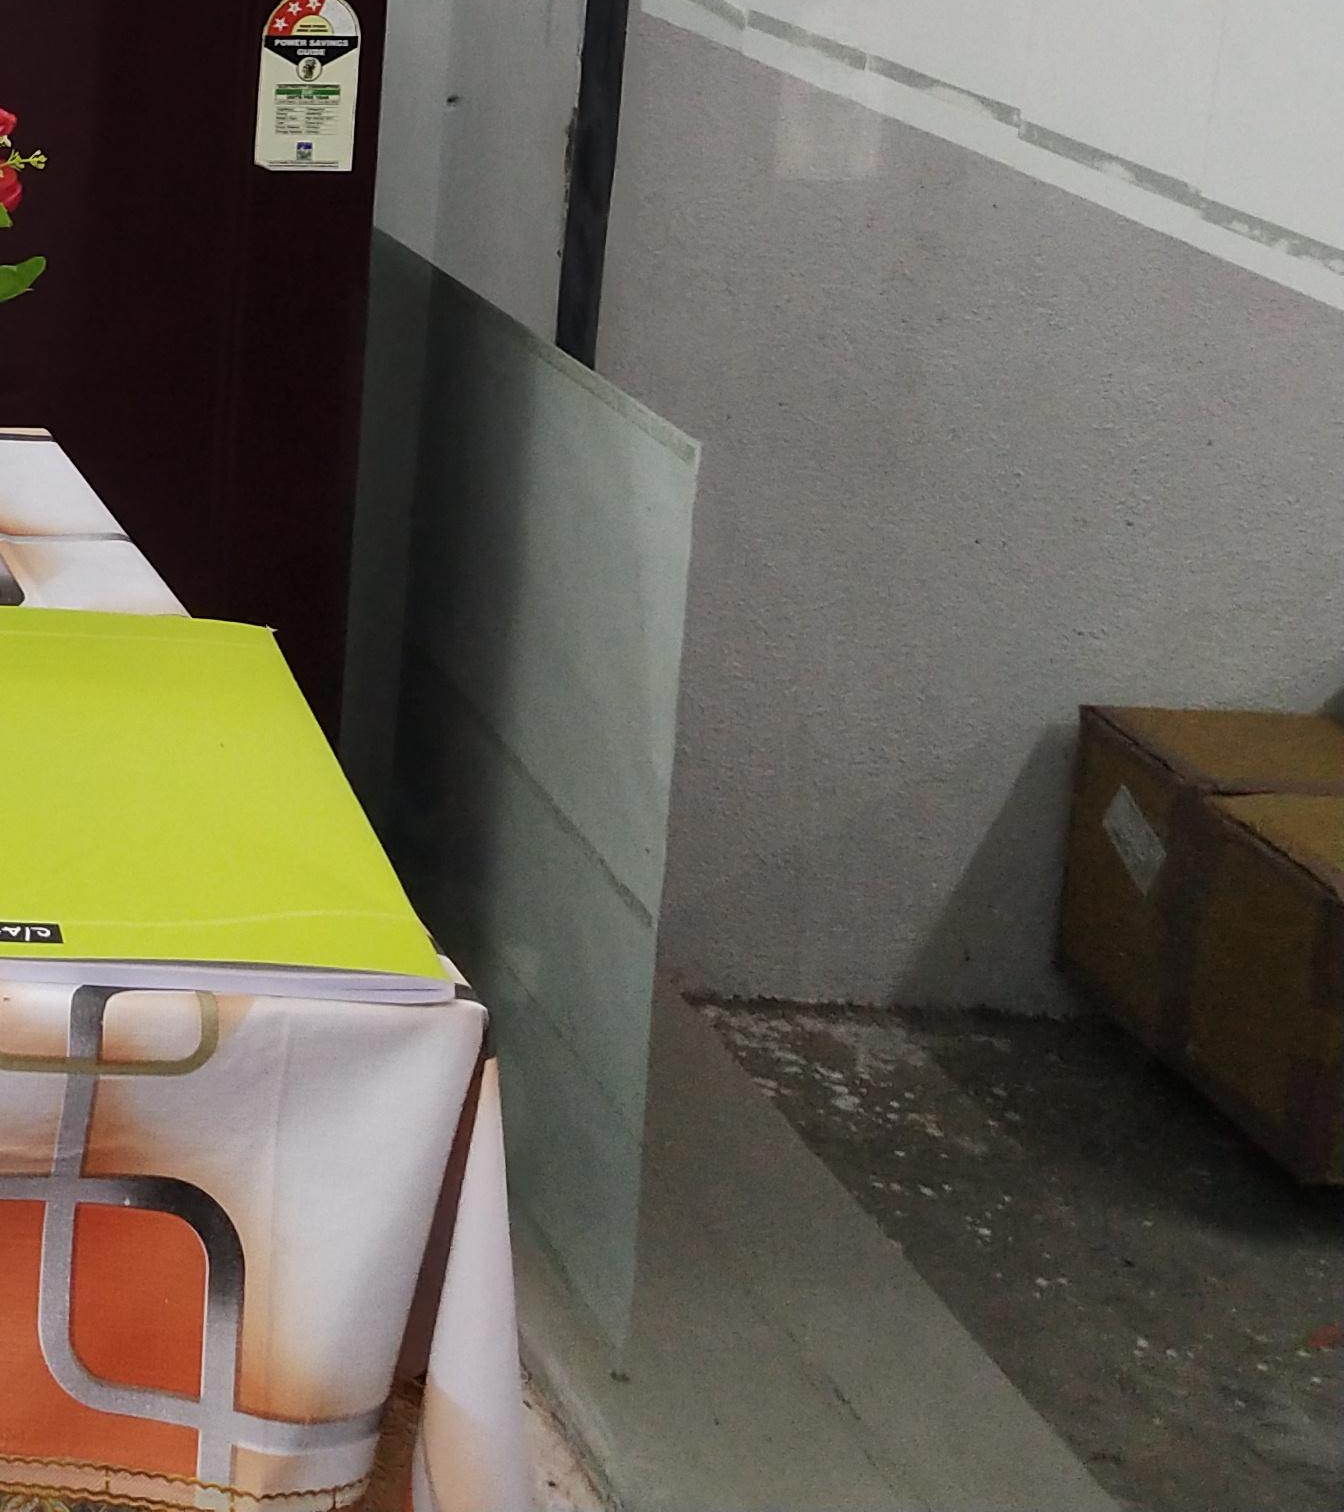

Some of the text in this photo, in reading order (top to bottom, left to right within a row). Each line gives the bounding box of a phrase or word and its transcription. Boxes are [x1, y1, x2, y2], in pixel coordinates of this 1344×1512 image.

[274, 39, 349, 47] POWER SAVINGS
[296, 48, 326, 56] GUIDE
